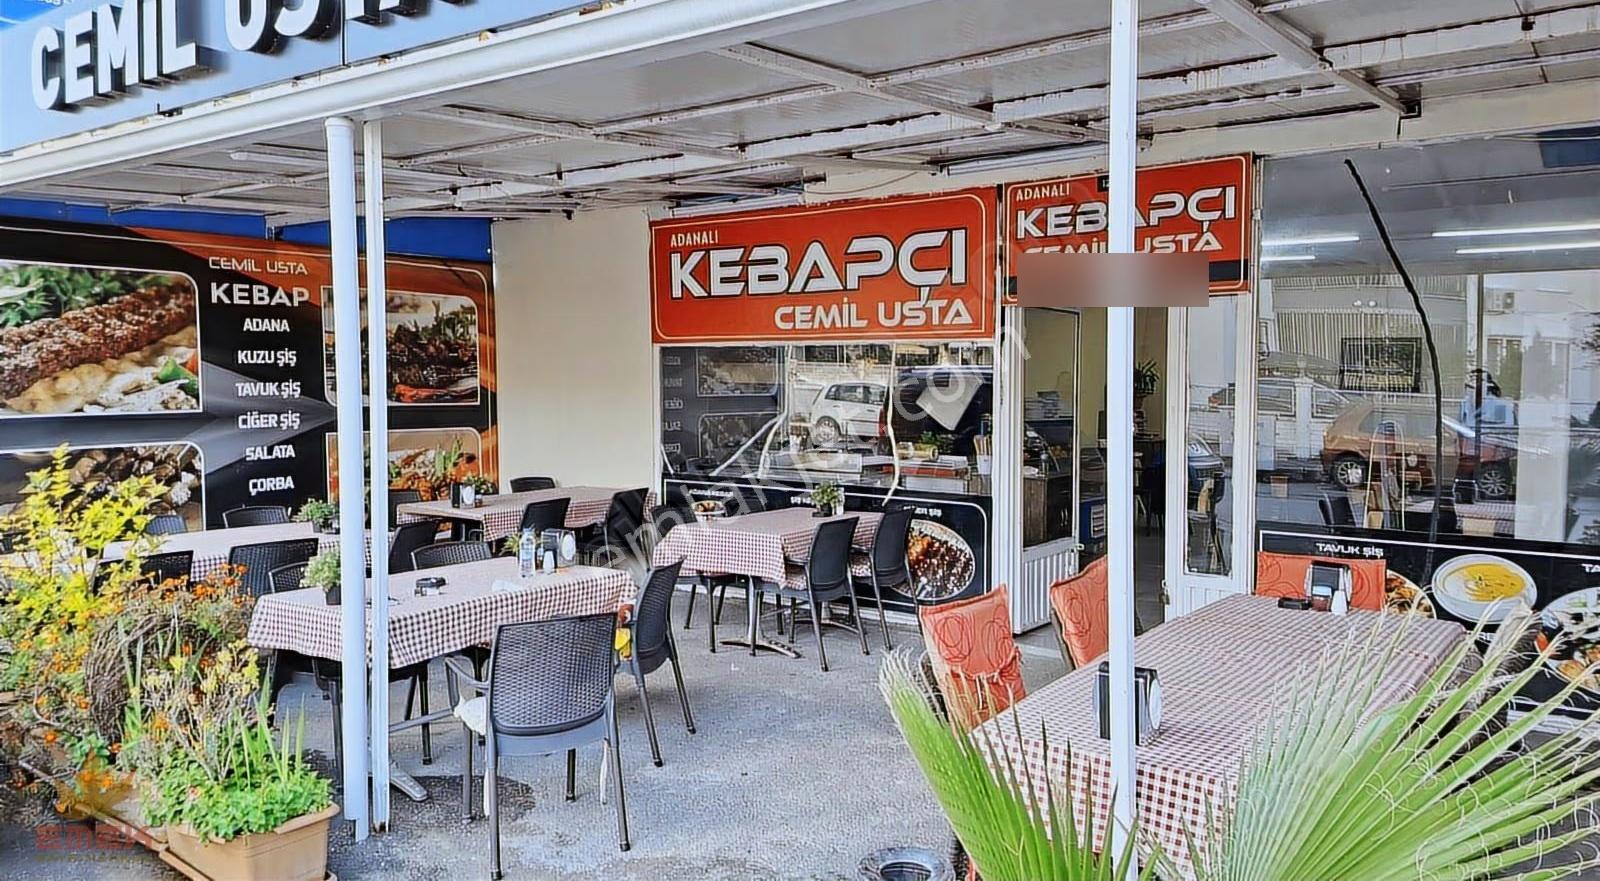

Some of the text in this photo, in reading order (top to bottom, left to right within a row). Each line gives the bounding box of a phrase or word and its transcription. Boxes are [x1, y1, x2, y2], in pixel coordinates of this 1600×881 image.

[1016, 182, 1070, 201] ADANALI
[1016, 186, 1237, 240] KEBPÇI
[670, 231, 719, 248] ADANALI
[208, 256, 308, 275] CEMİL USTA
[670, 228, 967, 307] KEBAPÇI
[210, 282, 310, 307] KEBAP
[774, 297, 974, 330] CEMİL USTA
[243, 318, 290, 332] ADANA
[237, 348, 297, 367] KUZU ŞİŞ
[235, 380, 301, 399] TAVUK ŞİŞ
[238, 410, 300, 430] CİĞER ŞİŞ
[245, 444, 295, 461] SALATA
[248, 475, 294, 496] ÇORBA
[1315, 543, 1384, 559] TAVUK ŞİŞ
